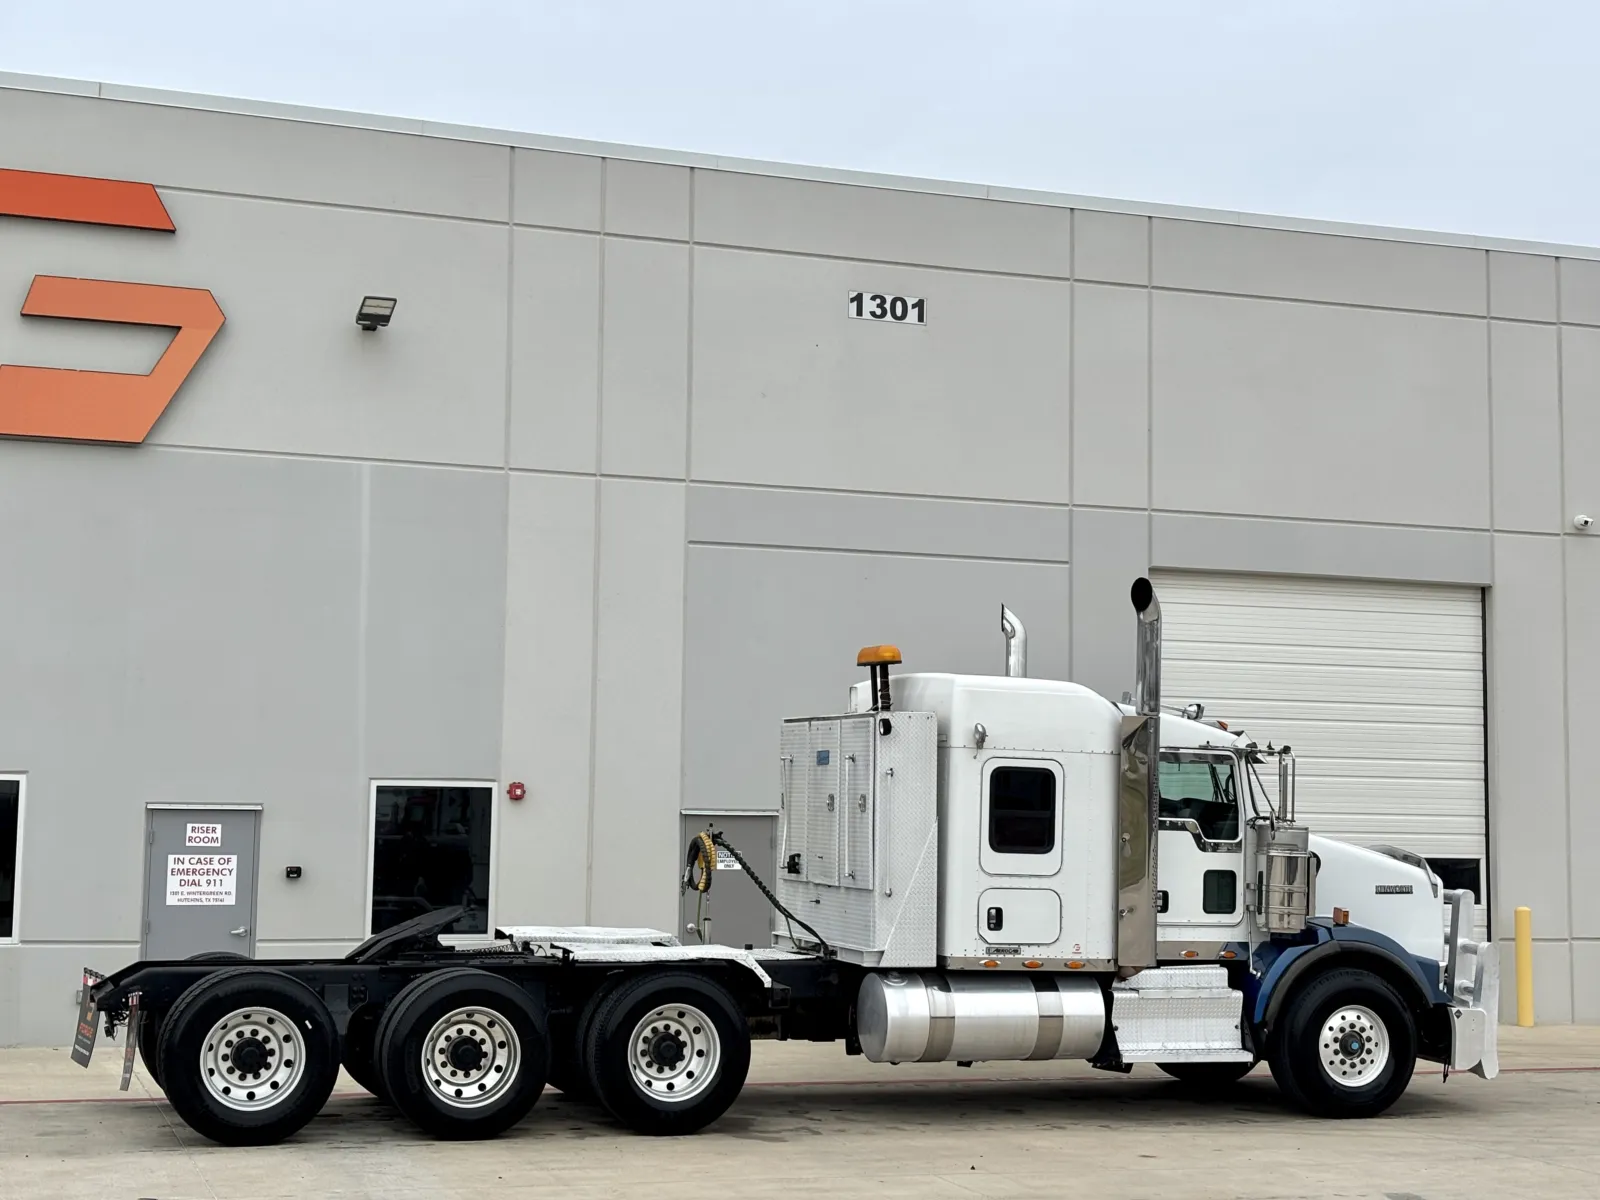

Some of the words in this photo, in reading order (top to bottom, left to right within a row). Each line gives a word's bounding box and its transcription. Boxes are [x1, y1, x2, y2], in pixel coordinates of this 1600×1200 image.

[849, 292, 925, 323] 1301
[190, 826, 217, 834] RISER
[187, 836, 219, 844] ROOM
[173, 857, 185, 865] IN
[188, 857, 214, 865] CASE
[217, 857, 232, 865] OF
[170, 868, 234, 876] EMERGENCY
[179, 879, 202, 887] DIAL
[205, 879, 223, 887] 911
